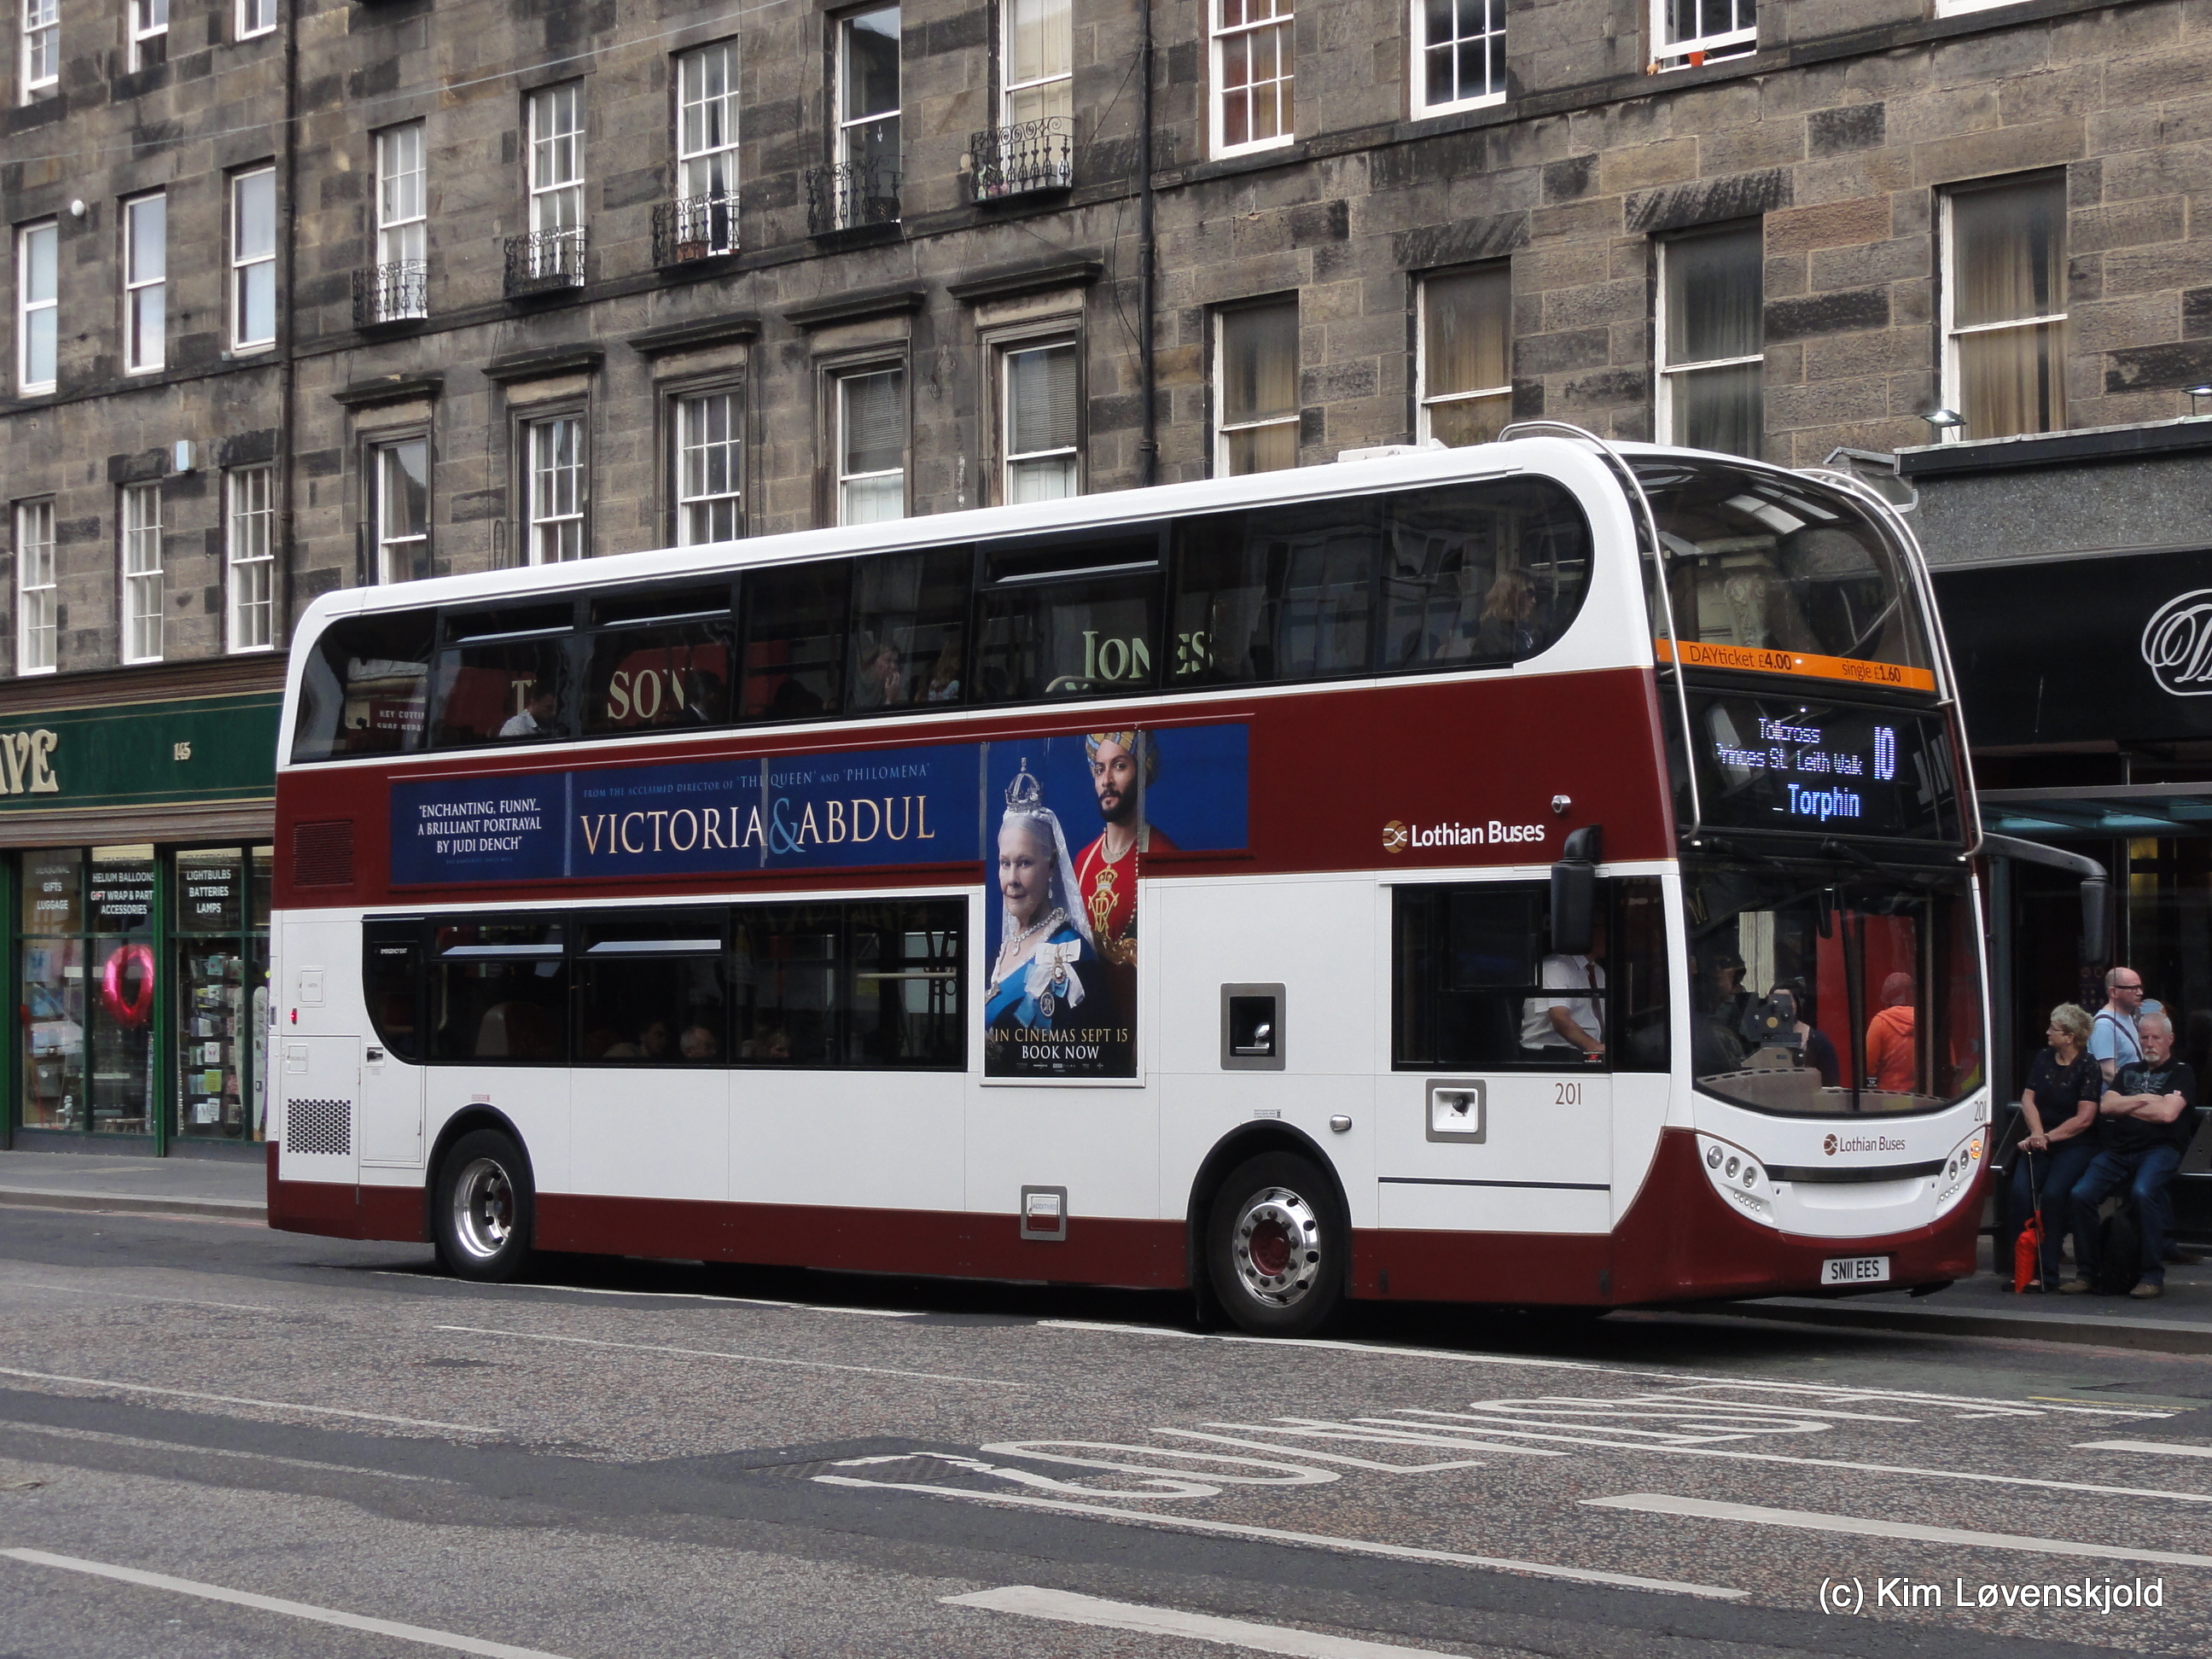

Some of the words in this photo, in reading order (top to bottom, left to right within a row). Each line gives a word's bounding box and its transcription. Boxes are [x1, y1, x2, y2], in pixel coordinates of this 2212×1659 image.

[1689, 644, 1754, 668] DAYticket
[1758, 652, 1793, 672] £4.00
[1842, 659, 1872, 681] single
[1874, 663, 1902, 684] £1.60
[1758, 717, 1821, 744] Tollcross
[0, 728, 60, 795] VE
[1796, 749, 1831, 773] Leith
[1833, 752, 1863, 776] Walk
[1873, 725, 1896, 780] 10
[583, 789, 606, 799] FROM
[609, 787, 626, 796] THE
[628, 783, 674, 795] ACCLAIMED
[677, 781, 720, 793] DIRECTOR
[722, 779, 734, 789] OF
[819, 773, 840, 783] AND
[1787, 783, 1860, 822] Torphin
[417, 823, 424, 836] A
[427, 819, 481, 835] BRILLIANT
[484, 816, 543, 833] PORTRAYAL
[1412, 821, 1484, 847] Lothian
[1488, 819, 1545, 844] Buses
[436, 840, 450, 853] BY
[452, 838, 477, 856] JUDI
[92, 872, 118, 883] HELIUM
[186, 869, 232, 881] LIGHTBULBS
[43, 882, 62, 893] GIFTS
[90, 890, 106, 901] GIFT
[107, 890, 128, 901] WRAP
[129, 890, 135, 900] &
[135, 889, 154, 901] PART
[189, 885, 230, 897] BATTERIES
[37, 899, 69, 911] LUGGAGE
[101, 903, 148, 915] ACCESSORIES
[196, 902, 222, 914] LAMPS
[995, 1028, 1010, 1042] IN
[1015, 1027, 1075, 1043] CINEMAS
[1080, 1027, 1112, 1042] SEPT
[1116, 1028, 1128, 1043] 15
[1022, 1045, 1061, 1059] BOOK
[1065, 1045, 1100, 1059] NOW
[1554, 1082, 1582, 1106] 201
[1974, 1100, 1987, 1122] 201
[1840, 1136, 1877, 1152] Lothian
[1878, 1135, 1906, 1151] Buses
[1831, 1260, 1854, 1280] SN11
[1856, 1260, 1879, 1278] EES
